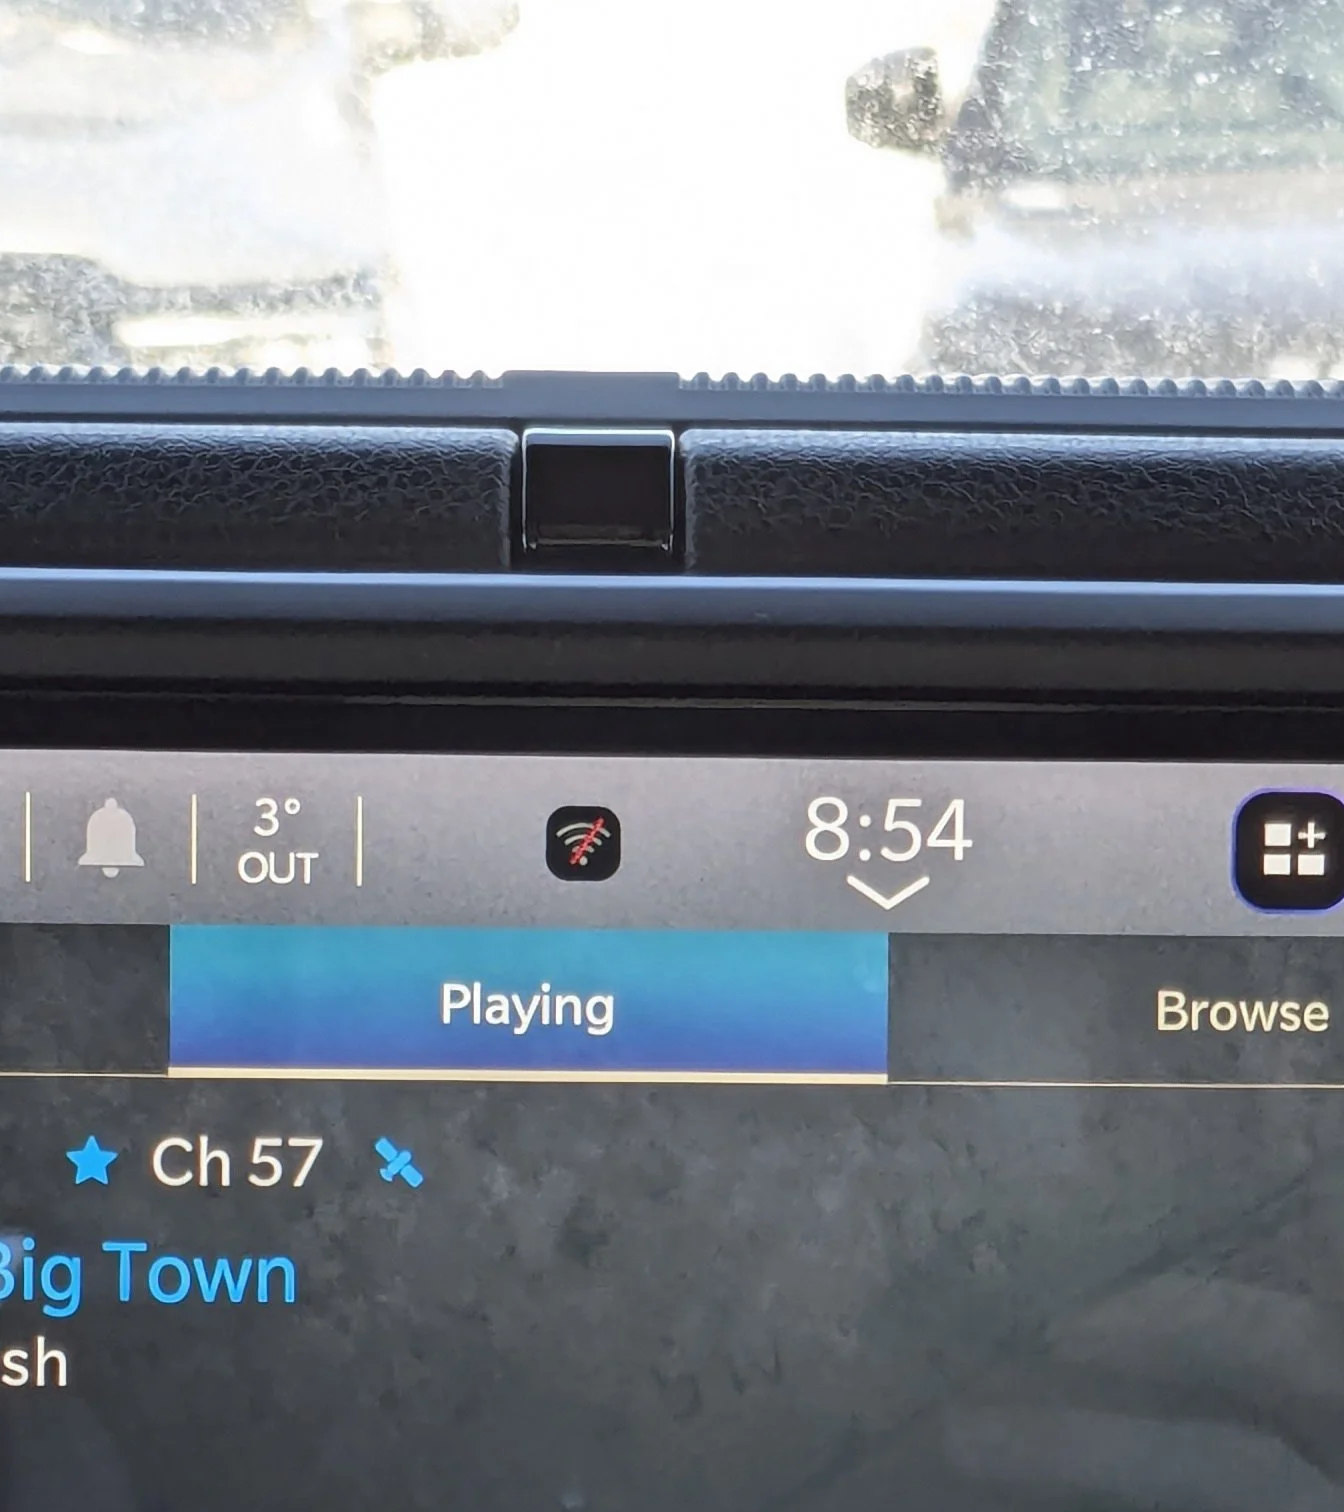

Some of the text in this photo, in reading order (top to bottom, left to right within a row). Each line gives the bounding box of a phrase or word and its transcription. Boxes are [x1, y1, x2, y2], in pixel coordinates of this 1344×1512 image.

[253, 797, 303, 837] 3°
[804, 795, 974, 864] 8:54
[237, 852, 319, 885] OUT
[441, 981, 616, 1036] Playing
[1156, 989, 1330, 1033] Browse
[152, 1136, 324, 1189] Ch 57
[101, 1240, 297, 1304] Town
